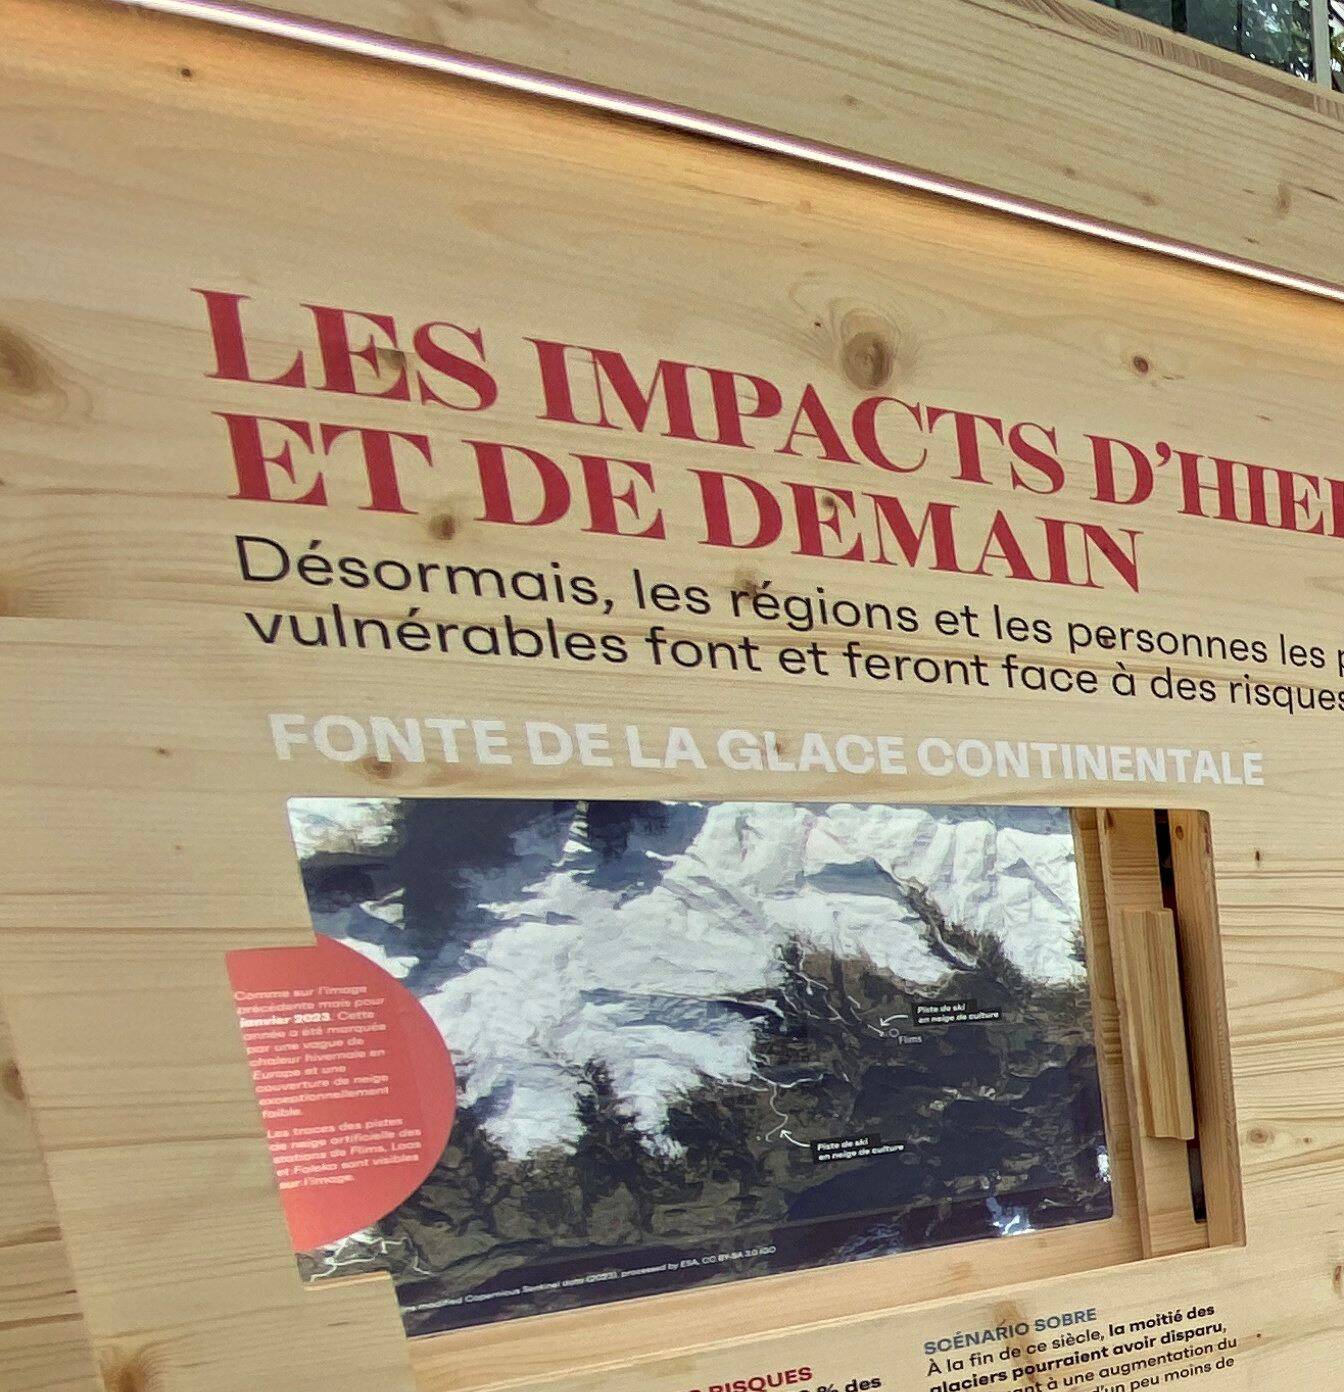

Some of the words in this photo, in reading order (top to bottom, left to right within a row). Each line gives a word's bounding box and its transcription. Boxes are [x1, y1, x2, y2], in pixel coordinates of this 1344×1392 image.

[190, 288, 499, 412] LES
[523, 337, 1065, 495] IMPACTS
[210, 411, 433, 515] ET
[461, 440, 667, 541] DE
[686, 468, 1141, 594] DEMAIN
[236, 534, 614, 616] Désormais,
[633, 568, 711, 615] les
[729, 579, 919, 633] régions
[934, 604, 980, 638] et
[993, 603, 1053, 644] les
[1067, 622, 1268, 664] personnes
[1279, 633, 1326, 669] les
[244, 606, 628, 664] vulnérables
[644, 629, 763, 673] font
[778, 641, 830, 676] et
[841, 643, 990, 687] feront
[1001, 655, 1098, 694] face
[1111, 664, 1136, 697] à
[1150, 667, 1217, 703] des
[271, 712, 512, 764] FONTE
[522, 720, 612, 768] DE
[623, 724, 706, 769] LA
[715, 728, 906, 774] GLACE
[915, 735, 1265, 786] CONTINENTALE
[923, 1320, 1030, 1356] SCÉNARIO
[1034, 1307, 1098, 1332] SOBRE
